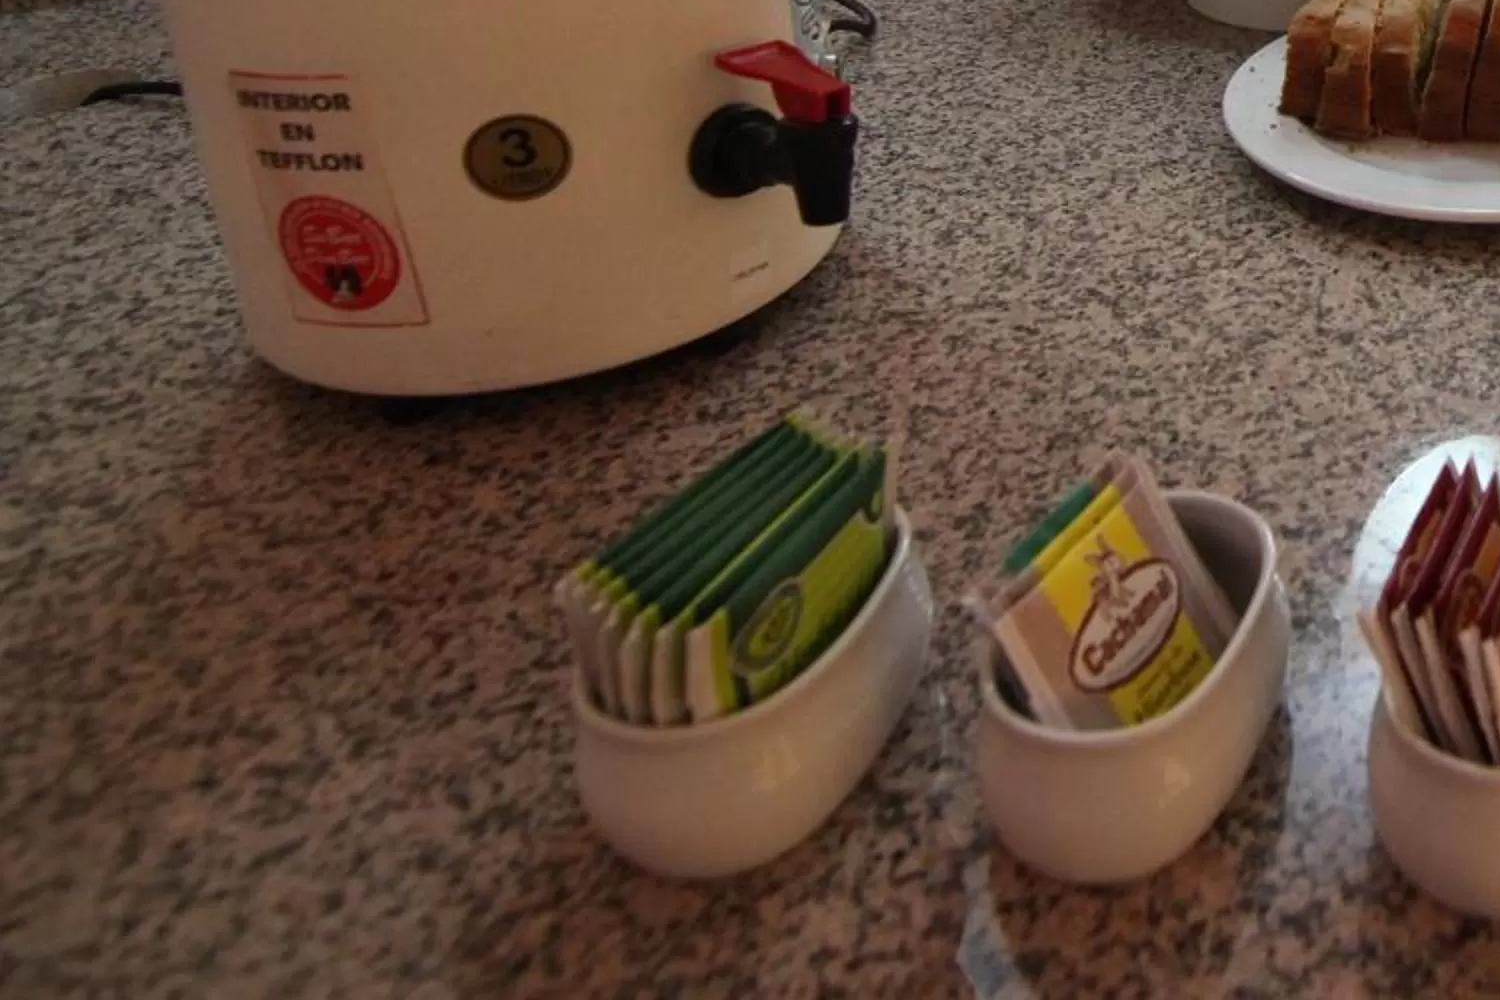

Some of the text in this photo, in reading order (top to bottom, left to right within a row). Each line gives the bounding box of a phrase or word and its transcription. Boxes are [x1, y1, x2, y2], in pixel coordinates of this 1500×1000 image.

[237, 89, 352, 112] INTERIOR
[280, 122, 316, 142] EN
[499, 128, 538, 167] 3
